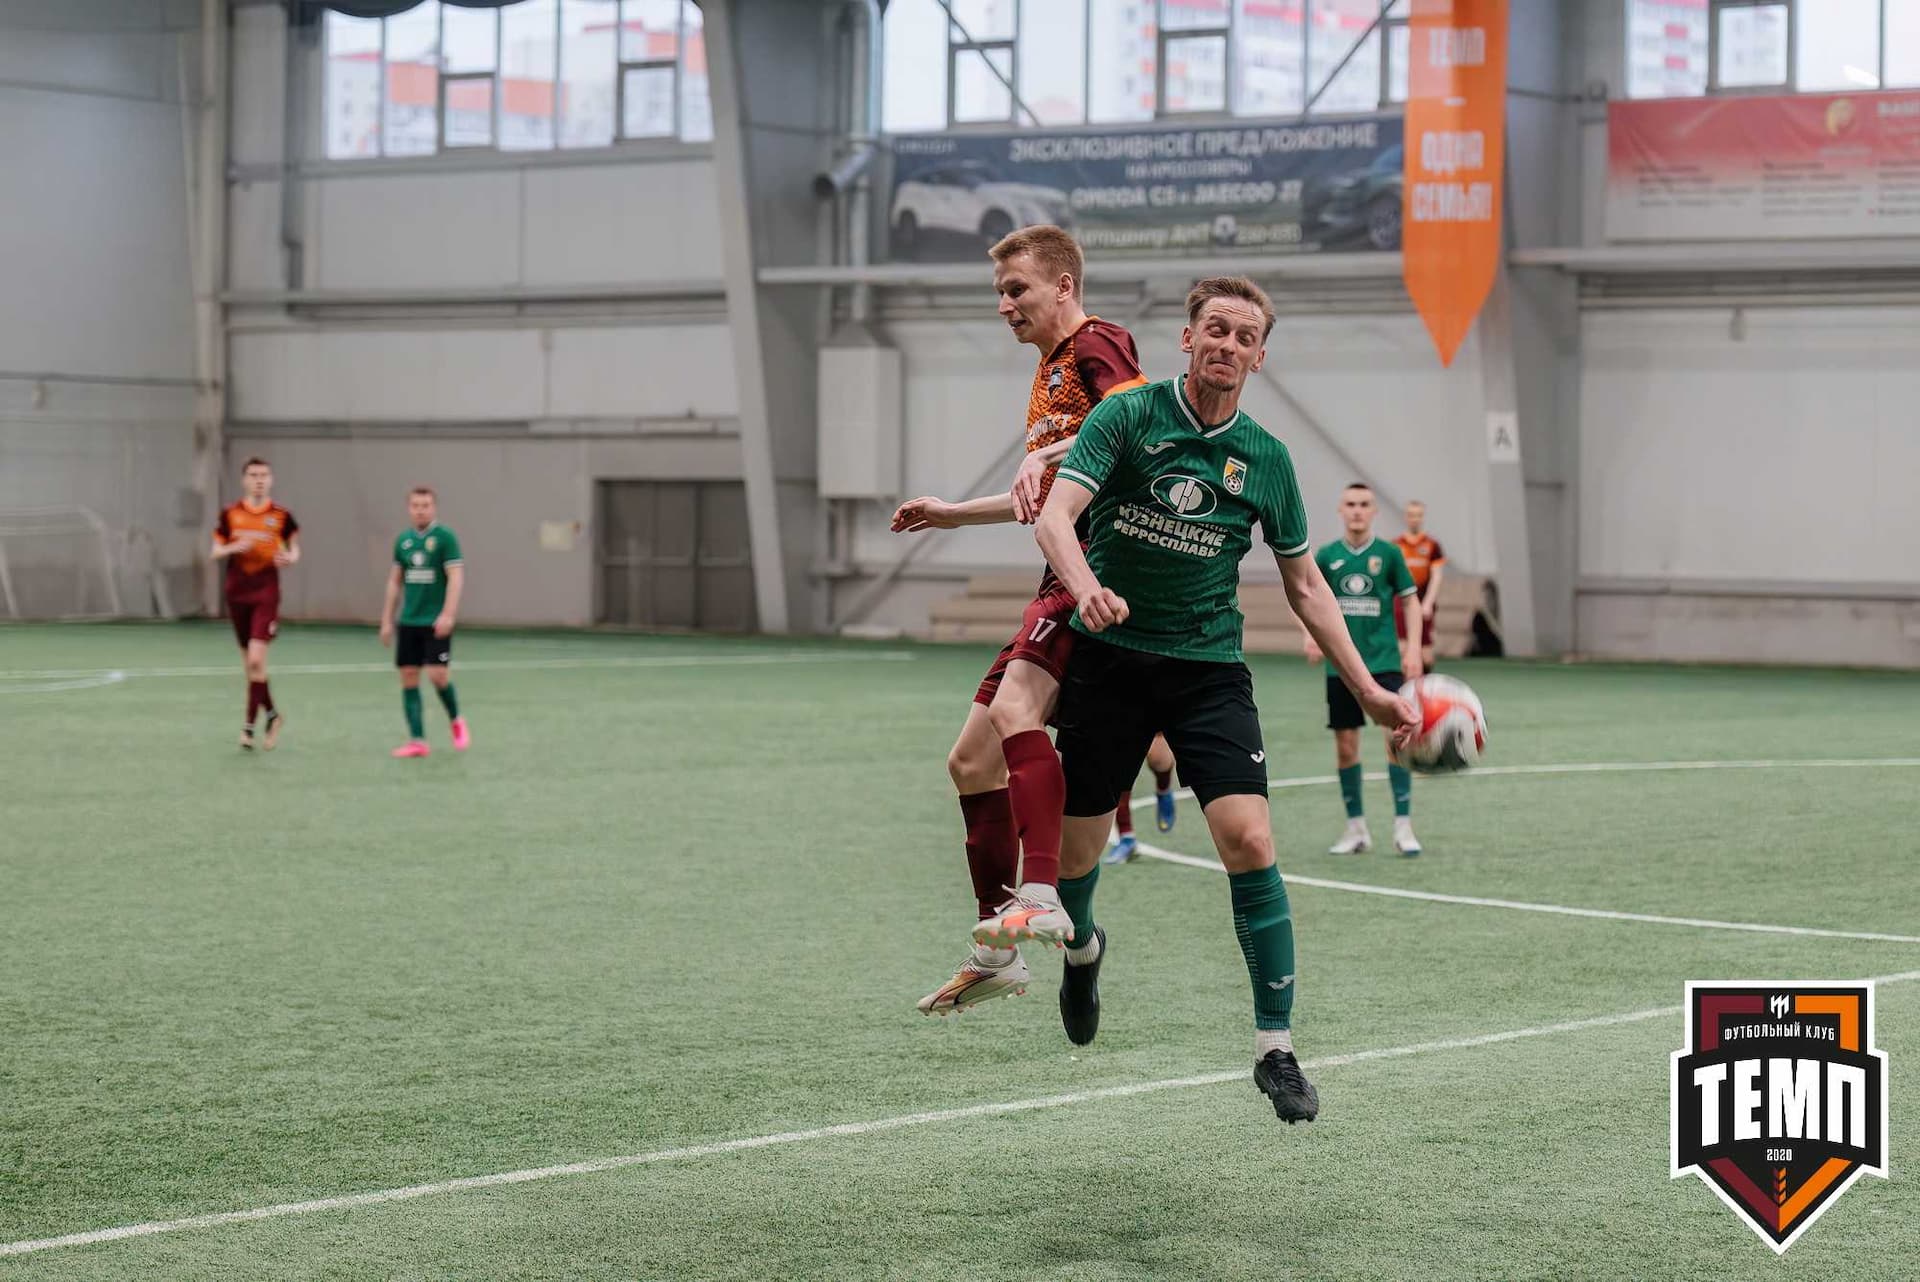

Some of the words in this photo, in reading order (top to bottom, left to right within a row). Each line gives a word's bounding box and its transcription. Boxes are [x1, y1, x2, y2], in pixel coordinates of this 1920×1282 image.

[1010, 134, 1192, 161] ЭКСКЛЮЗИВНОЕ
[1196, 124, 1377, 157] ПРЕДЛОЖЕНИЕ
[1113, 519, 1221, 558] ФЕРРОСПЛАВЫ
[1119, 504, 1226, 547] КУЗНЕЦКИЕ
[1029, 617, 1057, 642] 17
